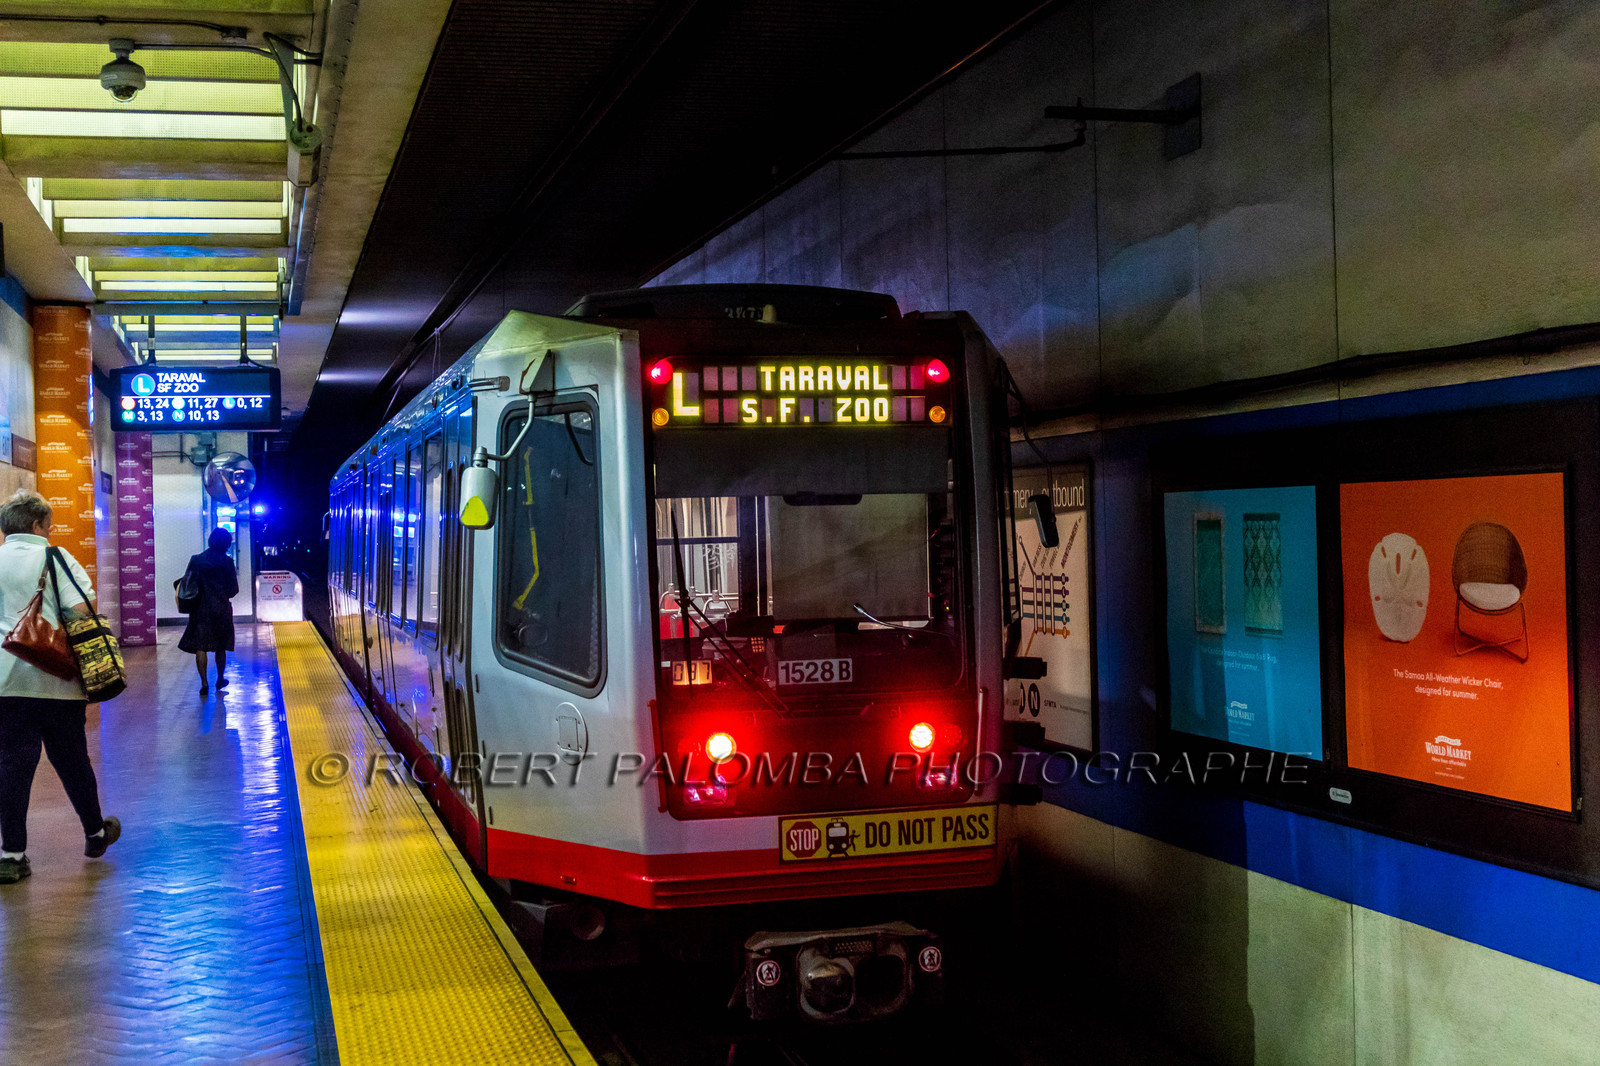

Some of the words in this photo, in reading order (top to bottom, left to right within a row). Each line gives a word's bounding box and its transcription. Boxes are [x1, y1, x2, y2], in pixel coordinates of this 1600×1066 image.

[138, 377, 150, 393] L
[156, 373, 206, 383] TARAVAL
[760, 365, 888, 391] TARAVAL
[157, 383, 172, 393] SF
[173, 383, 199, 393] ZOO
[672, 372, 700, 417] L
[137, 398, 154, 410] 13,
[156, 398, 170, 409] 24
[187, 398, 203, 410] 11,
[204, 398, 219, 409] 27
[237, 398, 248, 410] 0,
[250, 398, 263, 408] 12
[742, 398, 811, 424] S.F.
[836, 397, 889, 423] ZOO
[137, 410, 148, 422] 3,
[150, 410, 163, 421] 13
[187, 410, 204, 422] 10,
[206, 410, 219, 421] 13
[1393, 668, 1404, 678] The
[1404, 670, 1425, 680] Samoa
[1461, 675, 1483, 687] Wicker
[1415, 685, 1442, 697] designed
[1442, 686, 1451, 697] for
[1425, 742, 1446, 756] WORLD
[1446, 745, 1472, 761] MARKET
[789, 828, 820, 852] STOP
[865, 820, 891, 849] DO
[897, 817, 936, 847] NOT
[942, 813, 990, 842] PASS
